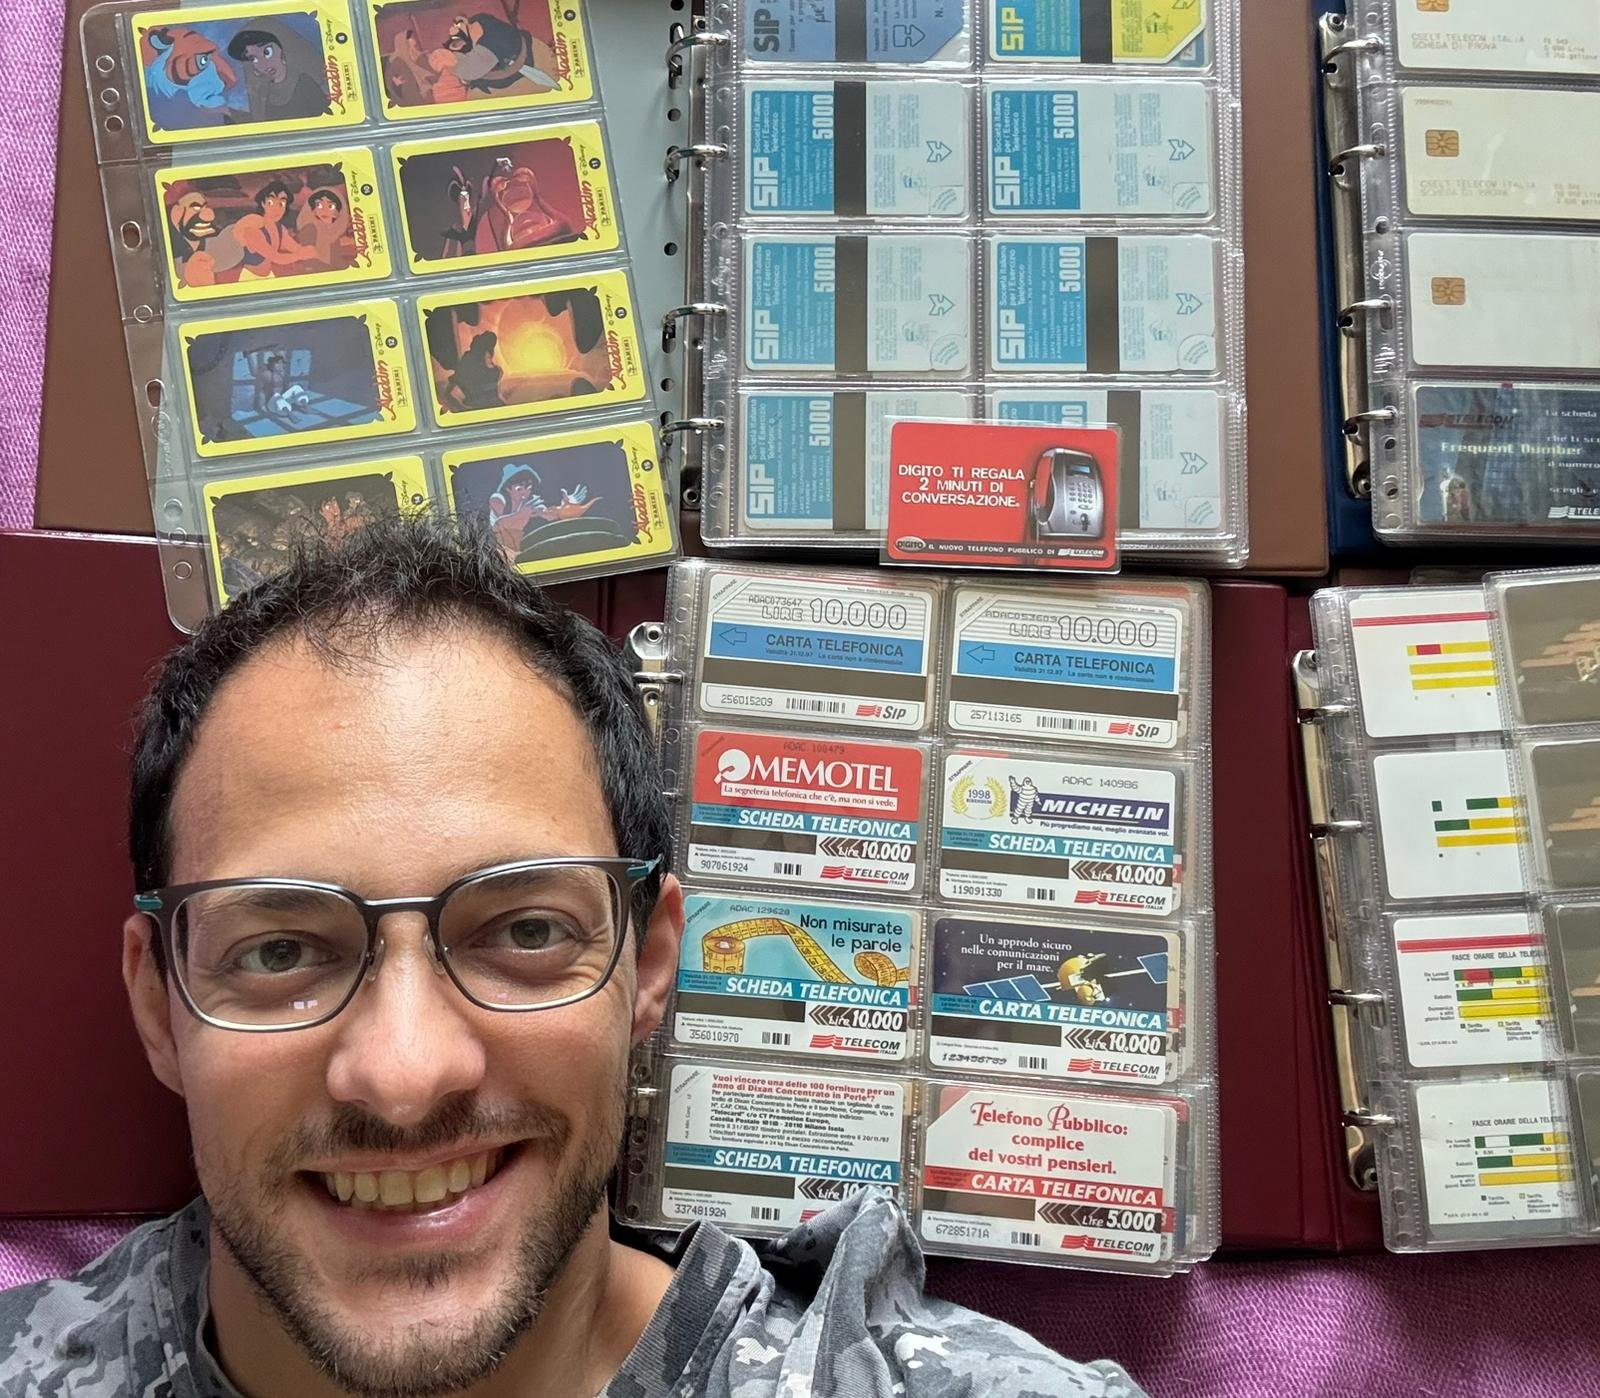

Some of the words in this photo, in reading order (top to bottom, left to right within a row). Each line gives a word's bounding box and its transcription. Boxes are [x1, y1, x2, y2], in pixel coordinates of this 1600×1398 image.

[753, 8, 780, 53] SIP
[1001, 7, 1024, 50] SIP
[554, 31, 574, 91] Aladdin
[326, 55, 346, 115] Aladdin
[344, 64, 354, 91] PANINI
[812, 94, 834, 139] 5000
[993, 93, 1002, 121] Italiana
[1053, 94, 1075, 138] 5000
[994, 123, 1002, 153] Società
[1013, 112, 1021, 153] Telefonico
[1003, 139, 1011, 153] per
[753, 157, 778, 207] SIP
[995, 157, 1020, 206] SIP
[580, 180, 600, 240] Aladdin
[596, 189, 607, 216] PANINI
[352, 207, 372, 268] Aladdin
[368, 216, 379, 244] PANINI
[814, 247, 835, 292] 5000
[1059, 247, 1081, 292] 5000
[754, 310, 780, 360] SIP
[1000, 309, 1025, 359] SIP
[606, 330, 627, 390] Aladdin
[373, 360, 397, 421] Aladdin
[809, 400, 830, 446] 5000
[1441, 442, 1514, 455] Frequent
[1521, 443, 1583, 455] Number
[898, 465, 943, 477] DIGITO
[952, 466, 963, 477] TI
[971, 468, 1025, 480] REGALA
[749, 464, 774, 514] SIP
[919, 478, 929, 491] 2
[937, 480, 982, 492] MINUTI
[990, 481, 1003, 492] DI
[650, 493, 660, 519] PANINI
[902, 492, 1020, 507] CONVERSAZIONE.
[631, 484, 653, 543] Aladdin
[897, 540, 924, 549] DIGITO
[968, 545, 1004, 553] TELEFONO
[1008, 547, 1043, 555] PUBBLICO
[761, 605, 804, 621] LIRE
[810, 597, 906, 630] 10.000
[1009, 623, 1052, 639] LIRE
[1058, 615, 1157, 648] 10.000
[766, 634, 812, 649] CARTA
[817, 638, 904, 657] TELEFONICA
[1014, 651, 1061, 666] CARTA
[1066, 656, 1155, 675] TELEFONICA
[721, 694, 773, 707] 256015209
[883, 705, 907, 720] SIP
[970, 709, 1022, 723] 257113165
[1135, 723, 1160, 738] SIP
[751, 754, 898, 792] MEMOTEL
[1062, 776, 1093, 786] ADAC
[1099, 778, 1139, 789] 140986
[724, 785, 733, 793] La
[734, 786, 770, 796] segreteria
[772, 788, 807, 800] telefonica
[809, 792, 822, 800] che
[875, 799, 896, 807] vede.
[968, 789, 991, 799] 1998
[1041, 799, 1164, 820] MICHELIN
[738, 809, 805, 829] SCHEDA
[811, 816, 911, 839] TELEFONICA
[838, 845, 860, 857] Lire
[861, 841, 912, 862] 10.000
[989, 833, 1057, 853] SCHEDA
[1063, 840, 1166, 862] TELEFONICA
[701, 860, 748, 872] 907061924
[854, 867, 910, 881] TELECOM
[1091, 869, 1113, 881] Lire
[1114, 865, 1166, 886] 10.000
[952, 885, 1003, 898] 119091330
[1108, 892, 1166, 906] TELECOM
[730, 904, 754, 913] ADAC
[800, 914, 828, 930] Non
[833, 918, 903, 935] misurate
[832, 934, 845, 947] le
[851, 938, 902, 953] parole
[961, 944, 985, 955] nelle
[987, 948, 1060, 961] comunicazioni
[979, 933, 995, 944] Un
[997, 937, 1039, 949] approdo
[1042, 939, 1072, 951] sicuro
[997, 961, 1014, 971] per
[1026, 964, 1054, 972] mare.
[1498, 951, 1516, 959] DELLA
[726, 976, 793, 997] SCHEDA
[800, 984, 901, 1006] TELEFONICA
[828, 1014, 849, 1026] Lire
[851, 1010, 903, 1031] 10.000
[979, 999, 1042, 1019] CARTA
[1047, 1005, 1162, 1029] TELEFONICA
[689, 1029, 739, 1043] 356010970
[844, 1037, 900, 1050] TELECOM
[1084, 1037, 1107, 1050] Lire
[1109, 1032, 1161, 1055] 10.000
[1103, 1061, 1160, 1074] TELECOM
[713, 1074, 733, 1082] Vuoi
[734, 1075, 766, 1085] vincere
[786, 1080, 808, 1089] delle
[810, 1082, 824, 1090] 100
[826, 1084, 865, 1093] forniture
[867, 1088, 882, 1097] per
[748, 1085, 773, 1093] Dixan
[775, 1087, 830, 1098] Concentrato
[970, 1101, 1043, 1127] Telefono
[1047, 1103, 1128, 1136] Pubblico:
[1012, 1134, 1084, 1151] complice
[714, 1149, 782, 1171] SCHEDA
[788, 1156, 893, 1180] TELEFONICA
[968, 1148, 994, 1162] dei
[998, 1152, 1042, 1167] vostri
[1048, 1157, 1117, 1175] pensieri.
[818, 1187, 840, 1200] Lire
[971, 1174, 1035, 1194] CARTA
[1041, 1180, 1157, 1206] TELEFONICA
[674, 1204, 727, 1218] 33748192A
[1082, 1215, 1104, 1227] Lire
[1106, 1209, 1155, 1231] 5.000
[936, 1224, 990, 1239] 67285171A
[1096, 1238, 1155, 1252] TELECOM
